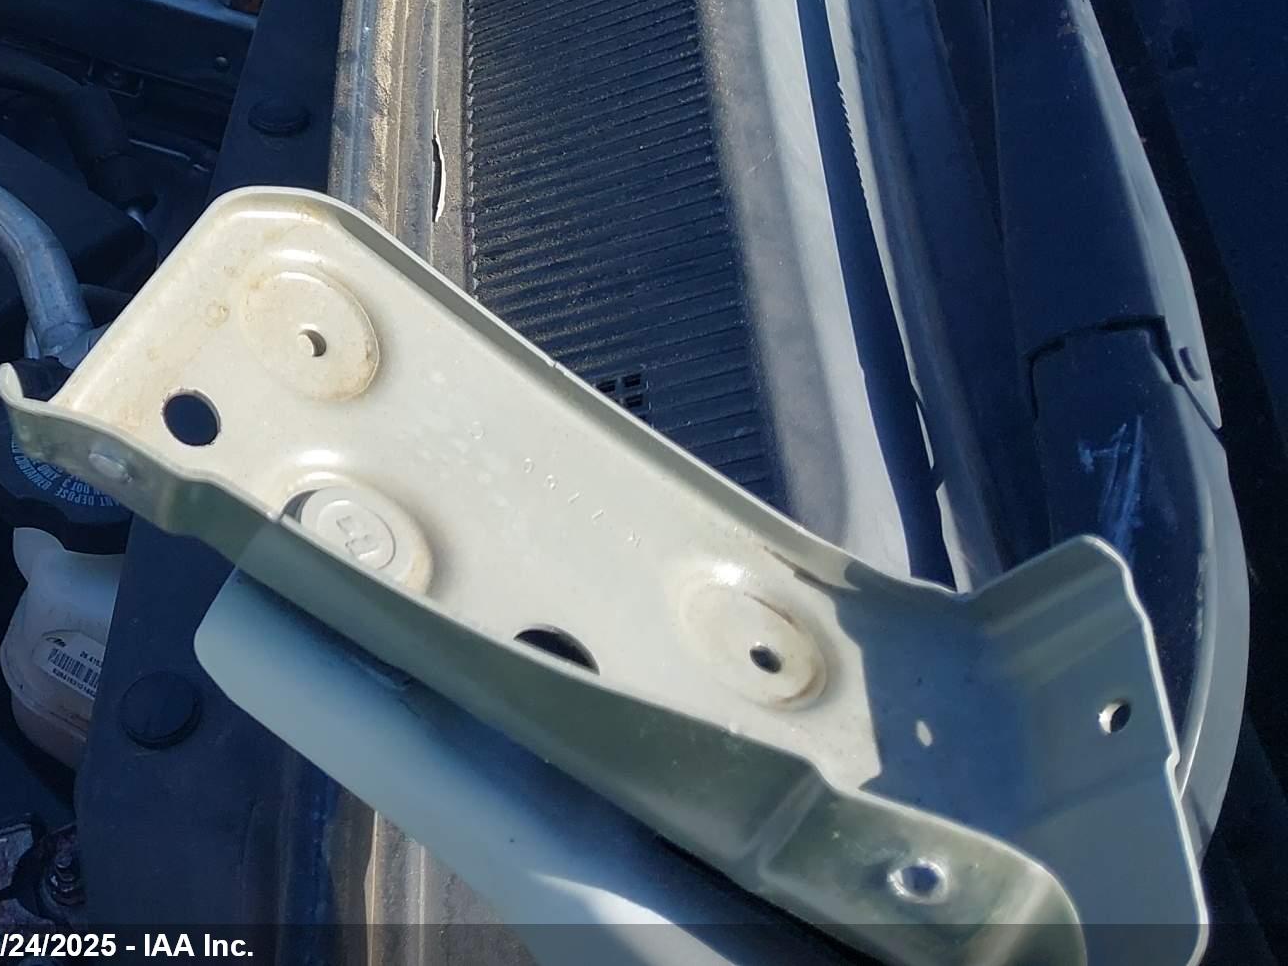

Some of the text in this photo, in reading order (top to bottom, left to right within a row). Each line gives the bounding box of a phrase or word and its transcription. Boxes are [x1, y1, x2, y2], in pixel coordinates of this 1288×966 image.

[62, 479, 71, 487] 3
[71, 480, 90, 494] DOT
[55, 487, 95, 506] DEPOSE
